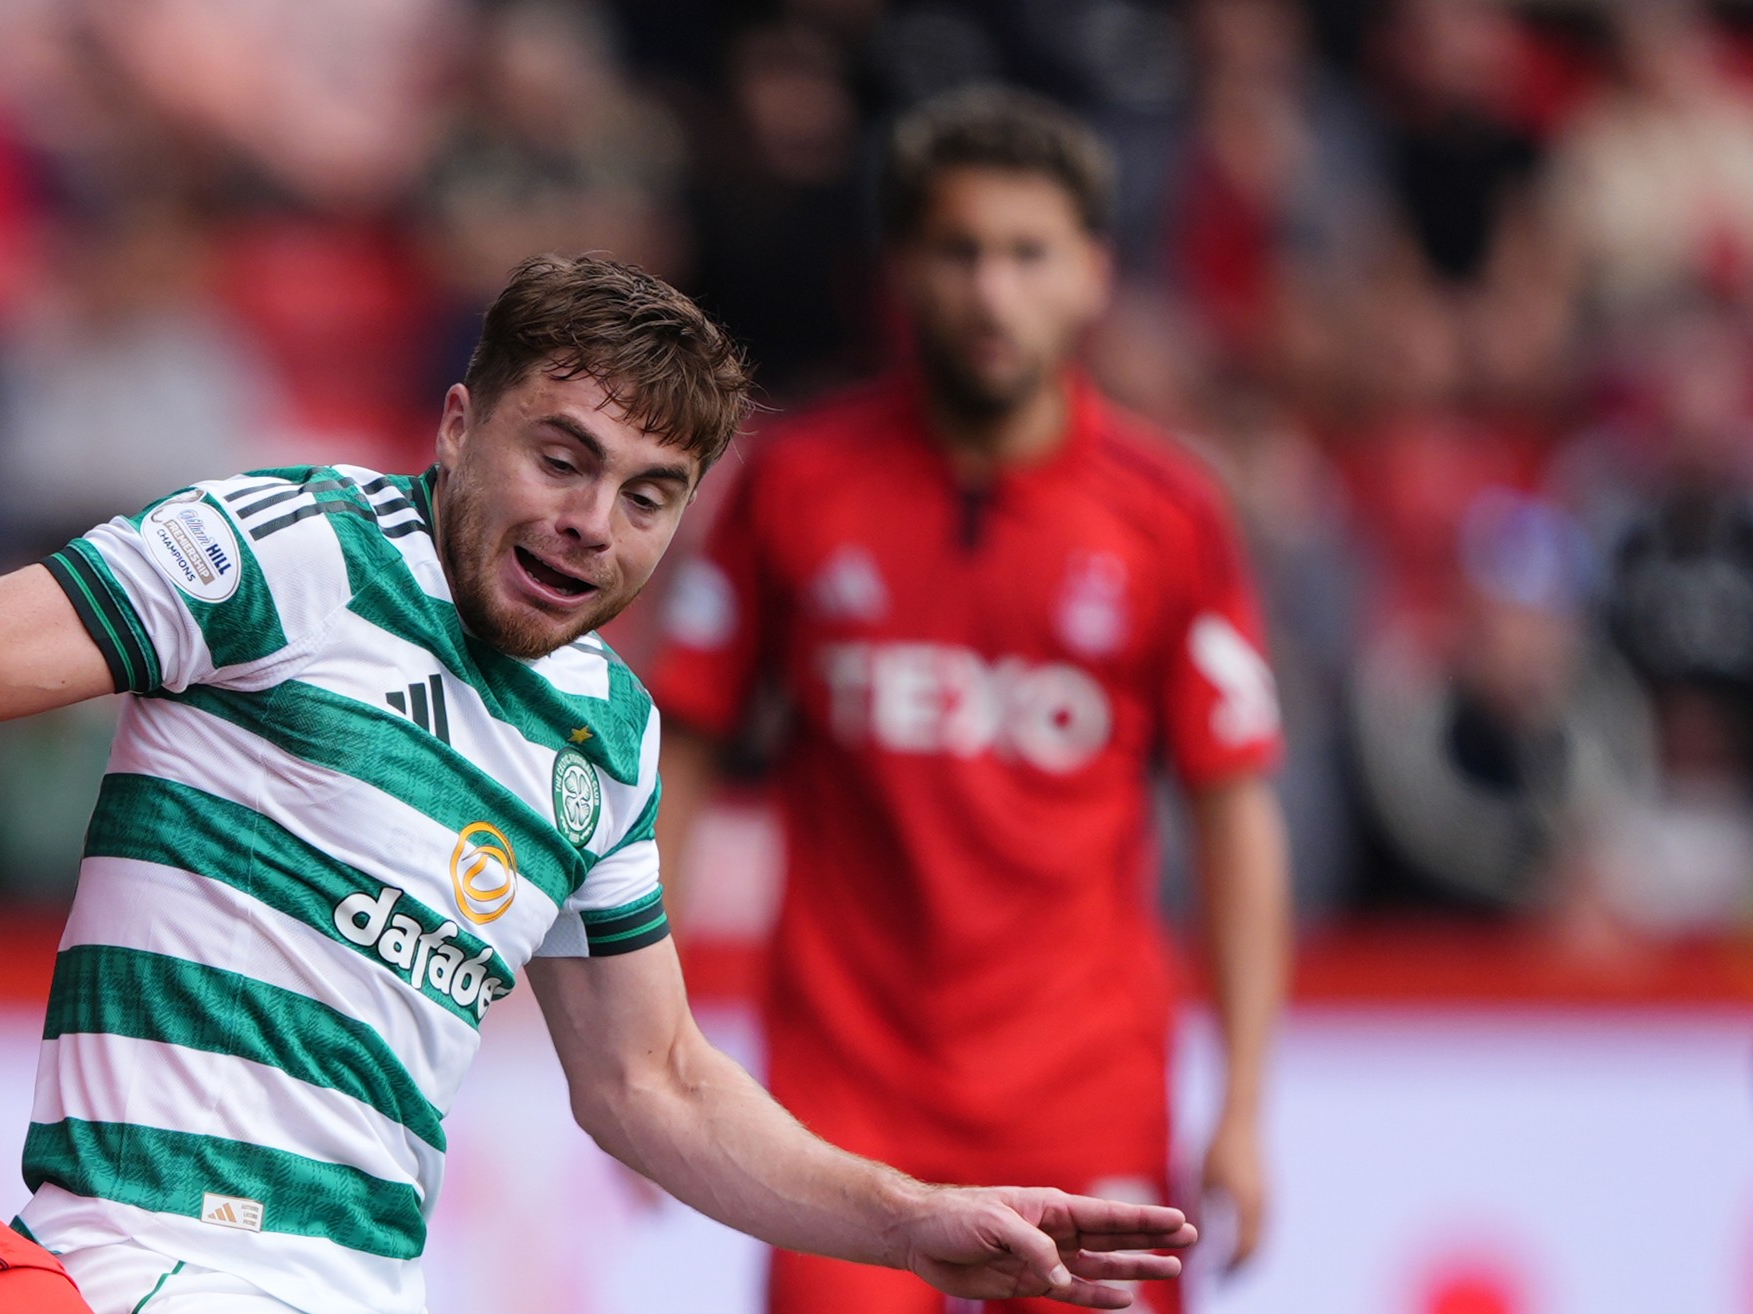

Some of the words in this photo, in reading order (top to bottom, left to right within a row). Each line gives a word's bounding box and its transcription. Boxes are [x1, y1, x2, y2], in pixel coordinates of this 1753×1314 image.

[156, 528, 197, 582] CHAMPIONS
[165, 520, 209, 579] PREMIERSHIP
[177, 509, 213, 547] William
[205, 543, 231, 576] HILL
[822, 640, 1113, 776] TEXO
[334, 886, 512, 1021] dafabe
